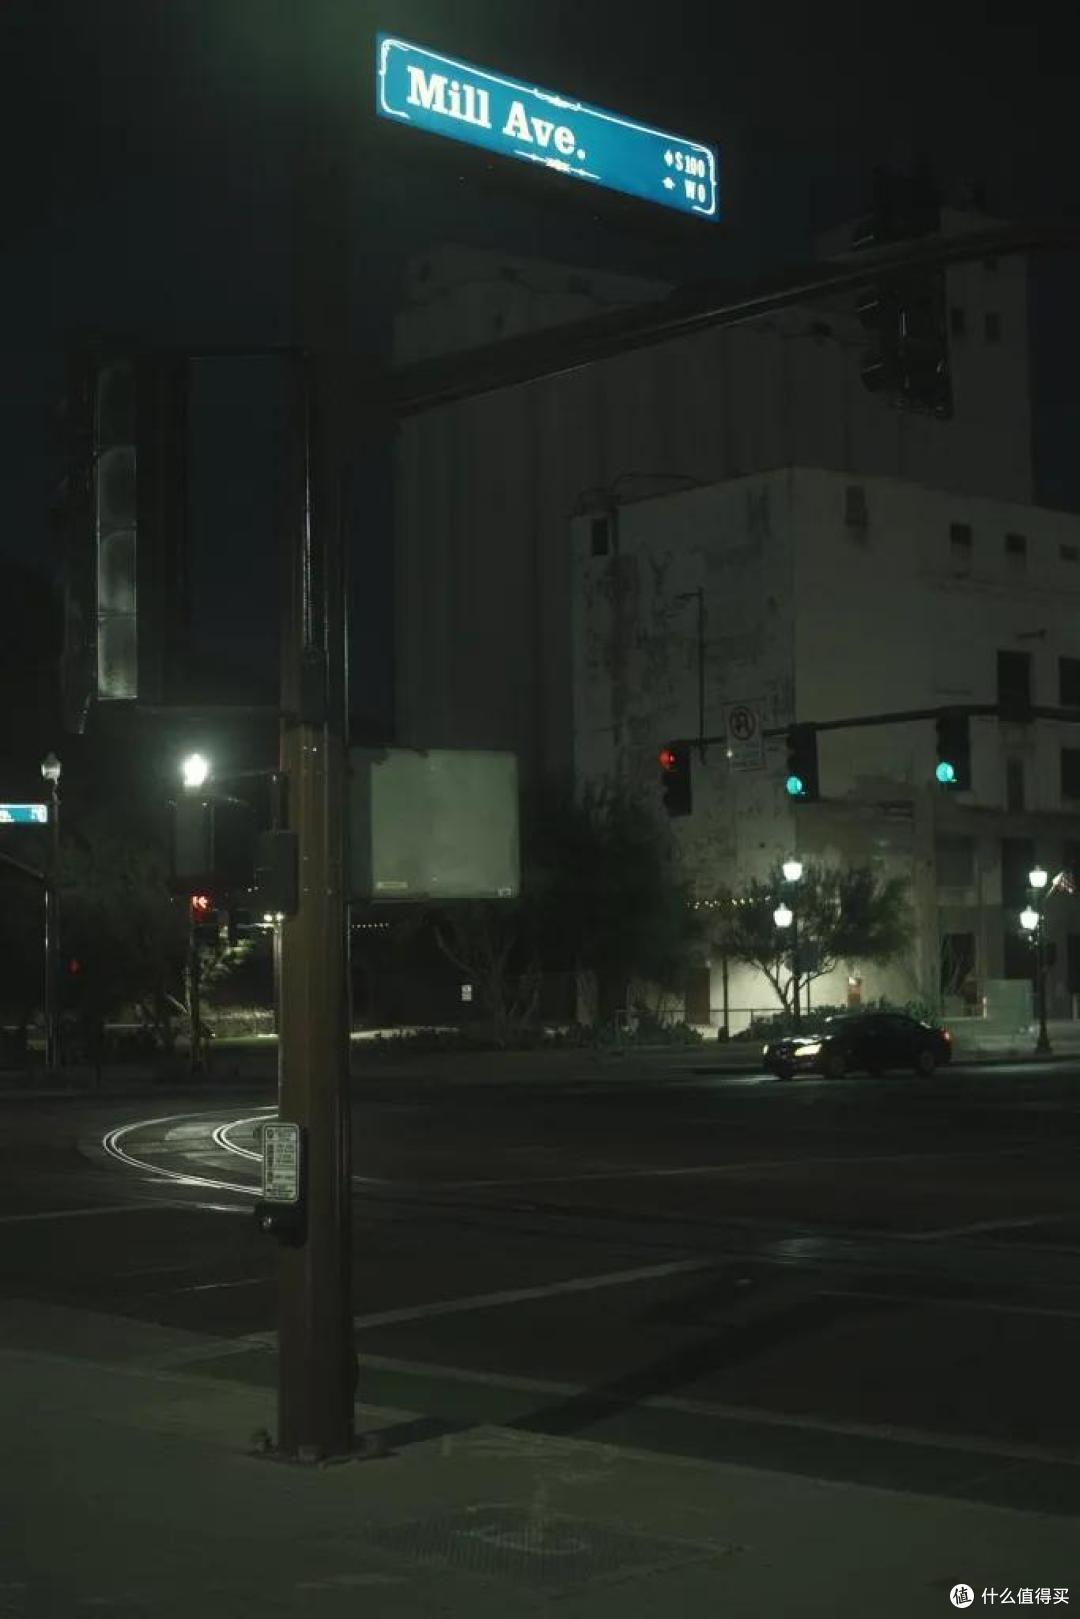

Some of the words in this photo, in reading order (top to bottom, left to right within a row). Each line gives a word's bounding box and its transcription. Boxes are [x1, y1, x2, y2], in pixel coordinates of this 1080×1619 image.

[407, 66, 491, 128] Mill
[503, 102, 586, 160] Ave.
[675, 151, 684, 171] S
